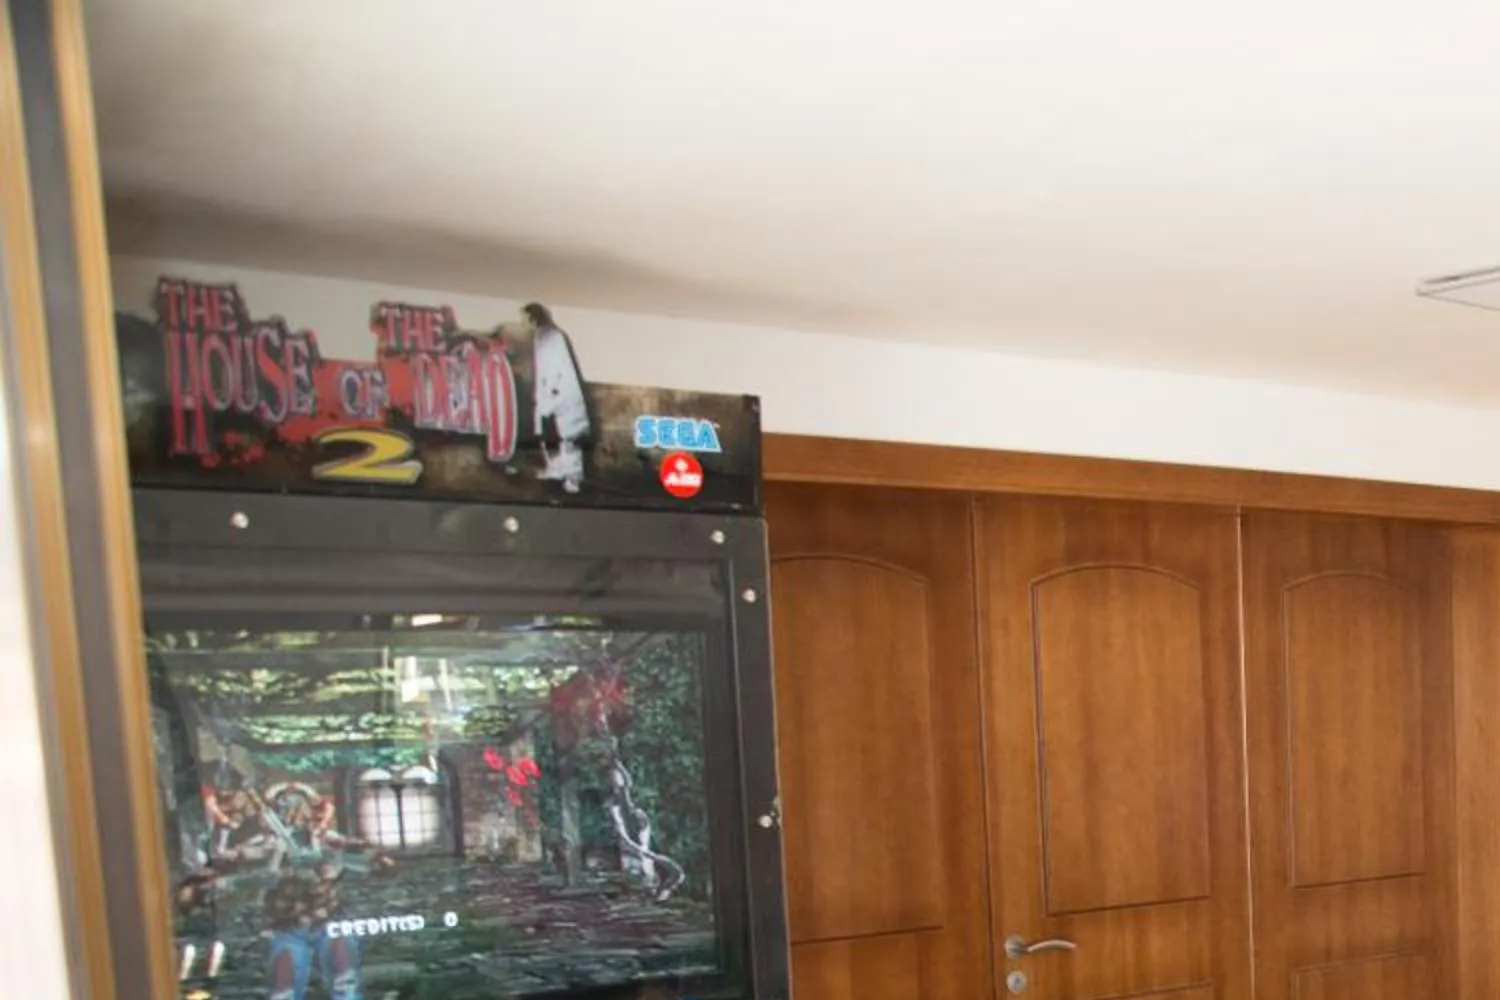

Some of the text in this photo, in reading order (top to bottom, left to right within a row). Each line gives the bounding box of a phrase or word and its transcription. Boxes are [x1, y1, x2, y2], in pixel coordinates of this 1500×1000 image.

[168, 324, 317, 455] HOUSE
[314, 426, 423, 484] 2
[633, 415, 722, 453] SEGA
